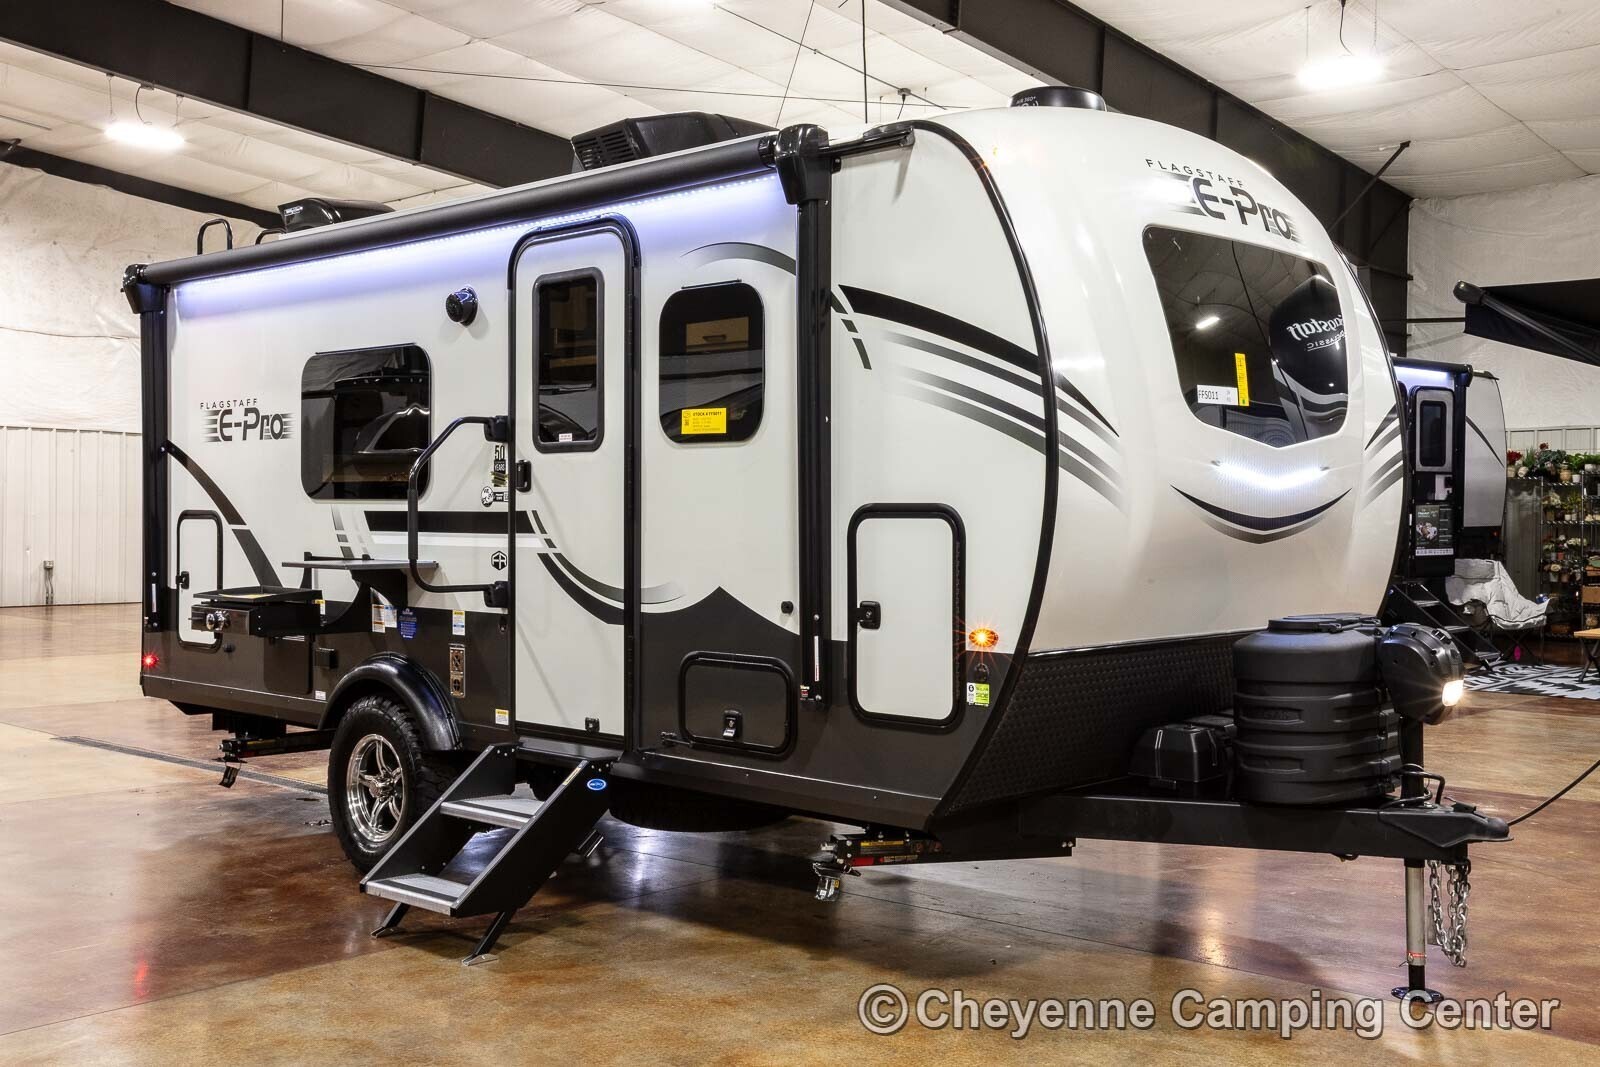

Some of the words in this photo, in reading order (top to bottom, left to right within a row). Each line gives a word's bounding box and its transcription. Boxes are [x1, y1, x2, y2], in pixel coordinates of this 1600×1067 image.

[1145, 158, 1244, 188] FLAGSTAFF
[1192, 177, 1293, 240] E-Pro
[200, 398, 257, 410] FLAGSTAFF
[219, 407, 284, 442] E-Pro
[494, 445, 505, 460] 50
